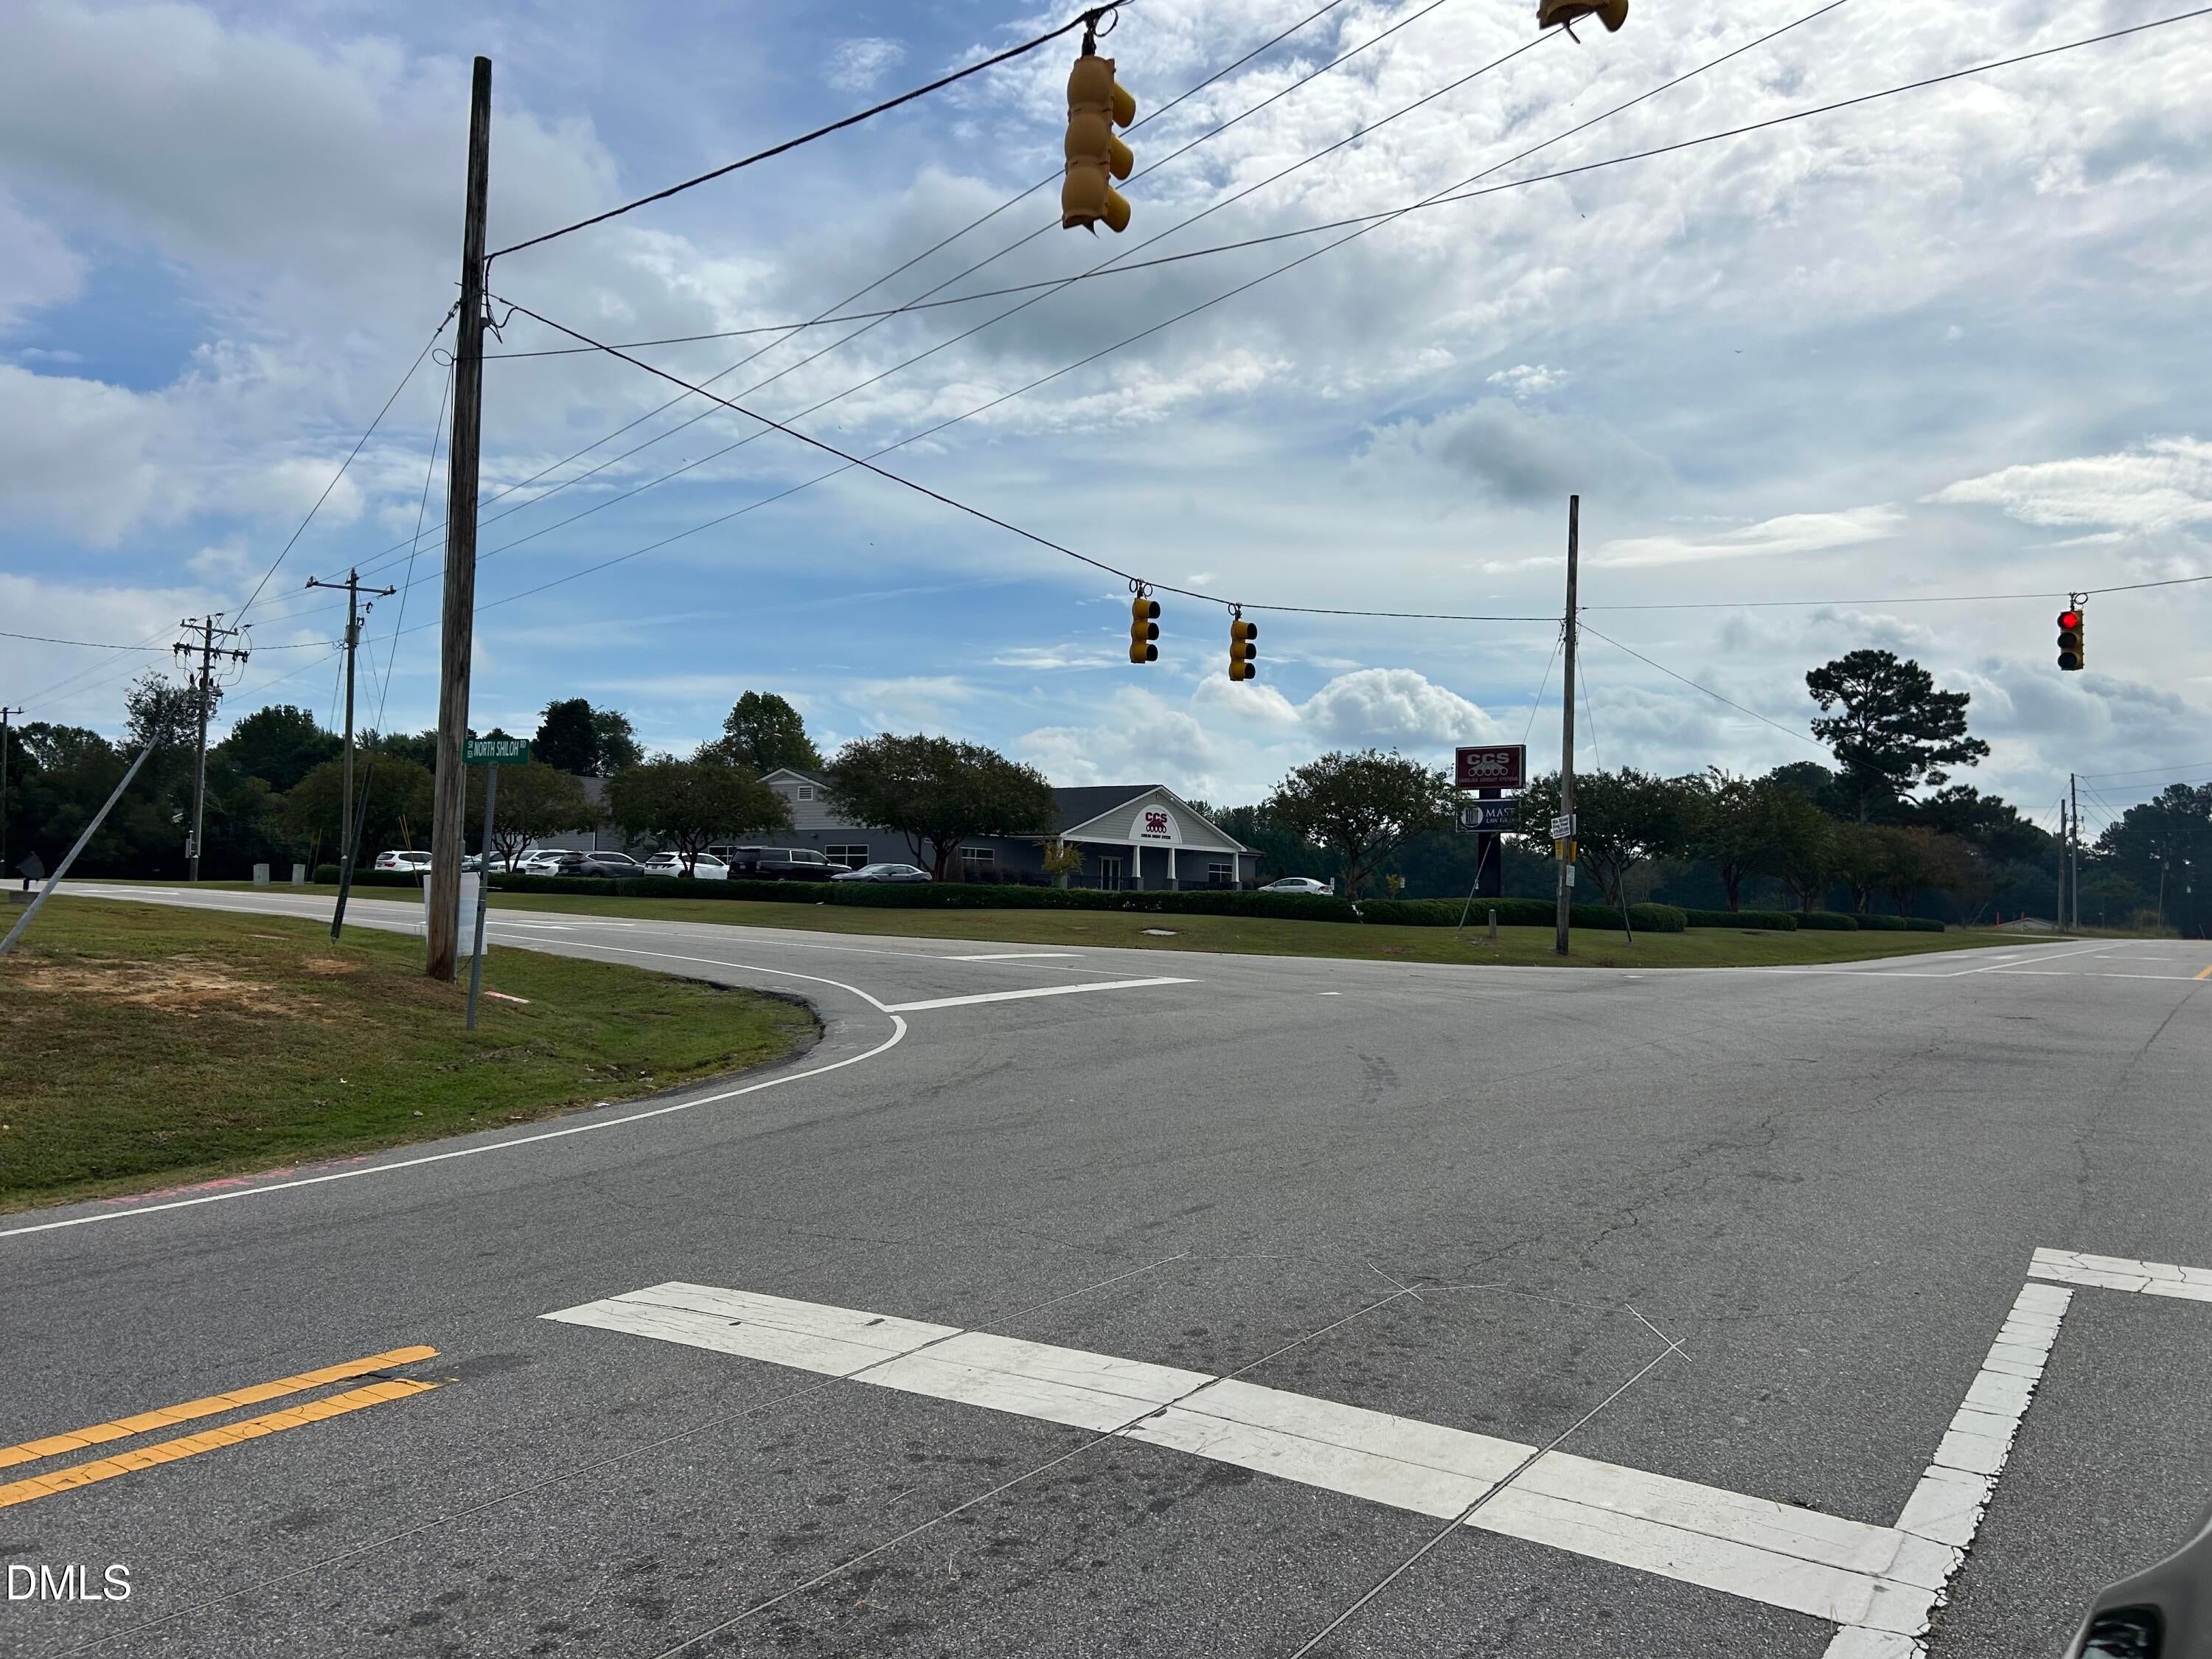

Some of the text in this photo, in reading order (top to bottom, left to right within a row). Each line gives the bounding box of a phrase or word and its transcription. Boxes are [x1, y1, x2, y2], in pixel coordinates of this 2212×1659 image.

[474, 741, 495, 757] NORTH
[496, 741, 519, 757] SHILOH
[1467, 753, 1510, 765] CCS
[1146, 812, 1167, 823] CCS
